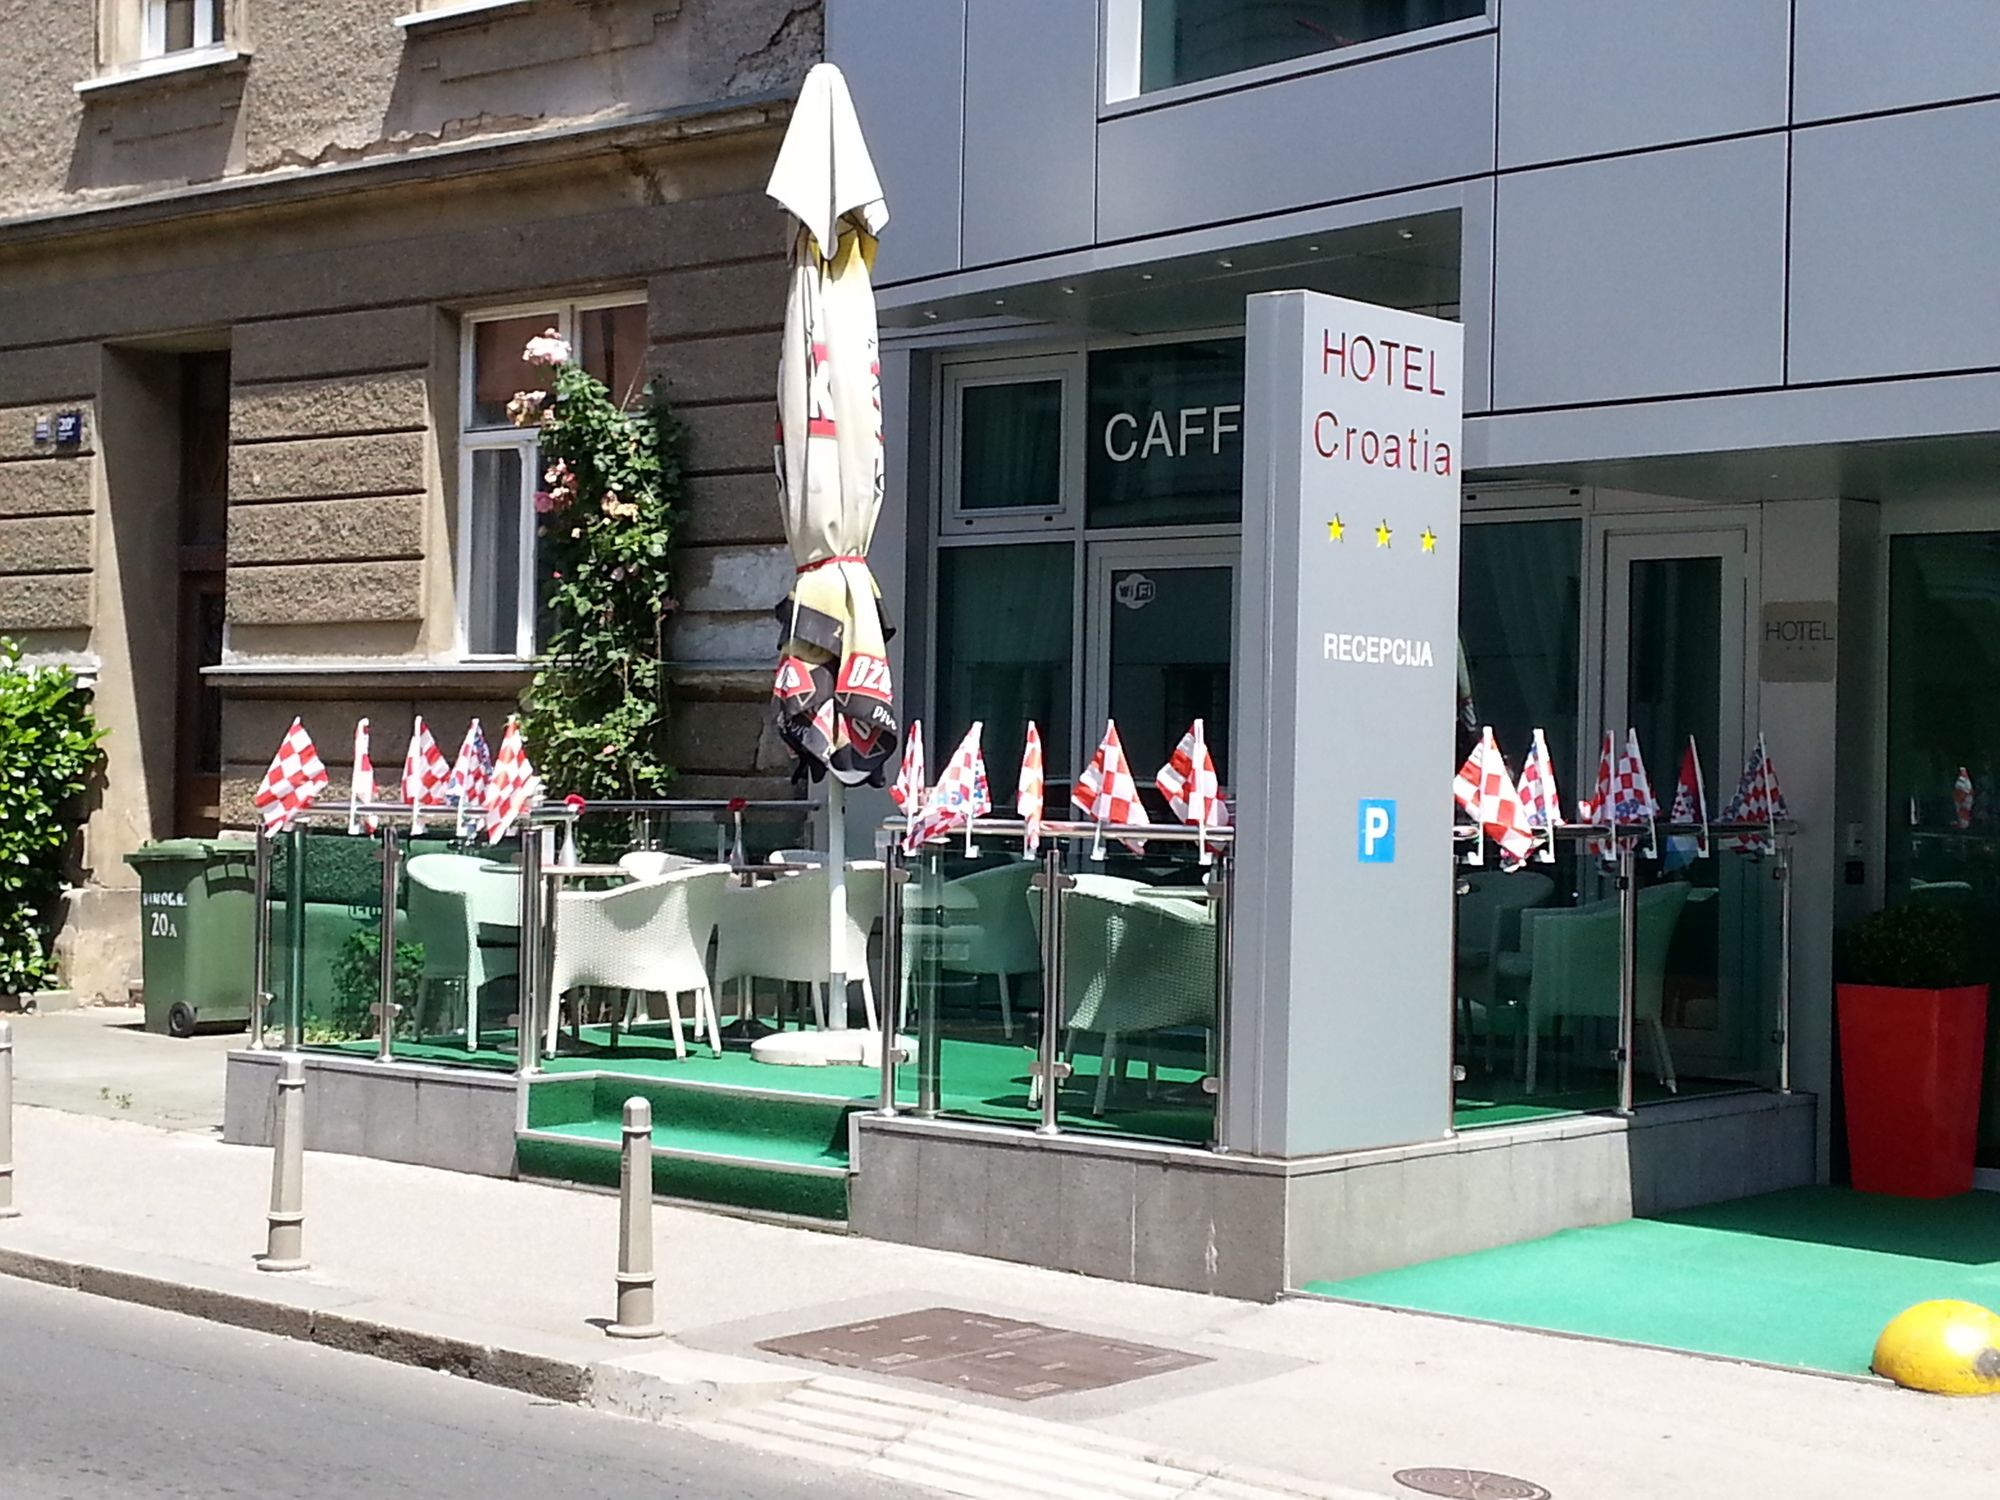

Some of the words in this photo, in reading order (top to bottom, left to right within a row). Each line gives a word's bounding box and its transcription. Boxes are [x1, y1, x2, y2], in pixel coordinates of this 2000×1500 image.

[1323, 328, 1446, 397] HOTEL
[1105, 404, 1242, 462] CAFF
[1314, 410, 1452, 477] Croatia
[1323, 632, 1435, 668] RECEPCIJA
[1765, 620, 1835, 641] HOTEL
[1365, 806, 1390, 856] P
